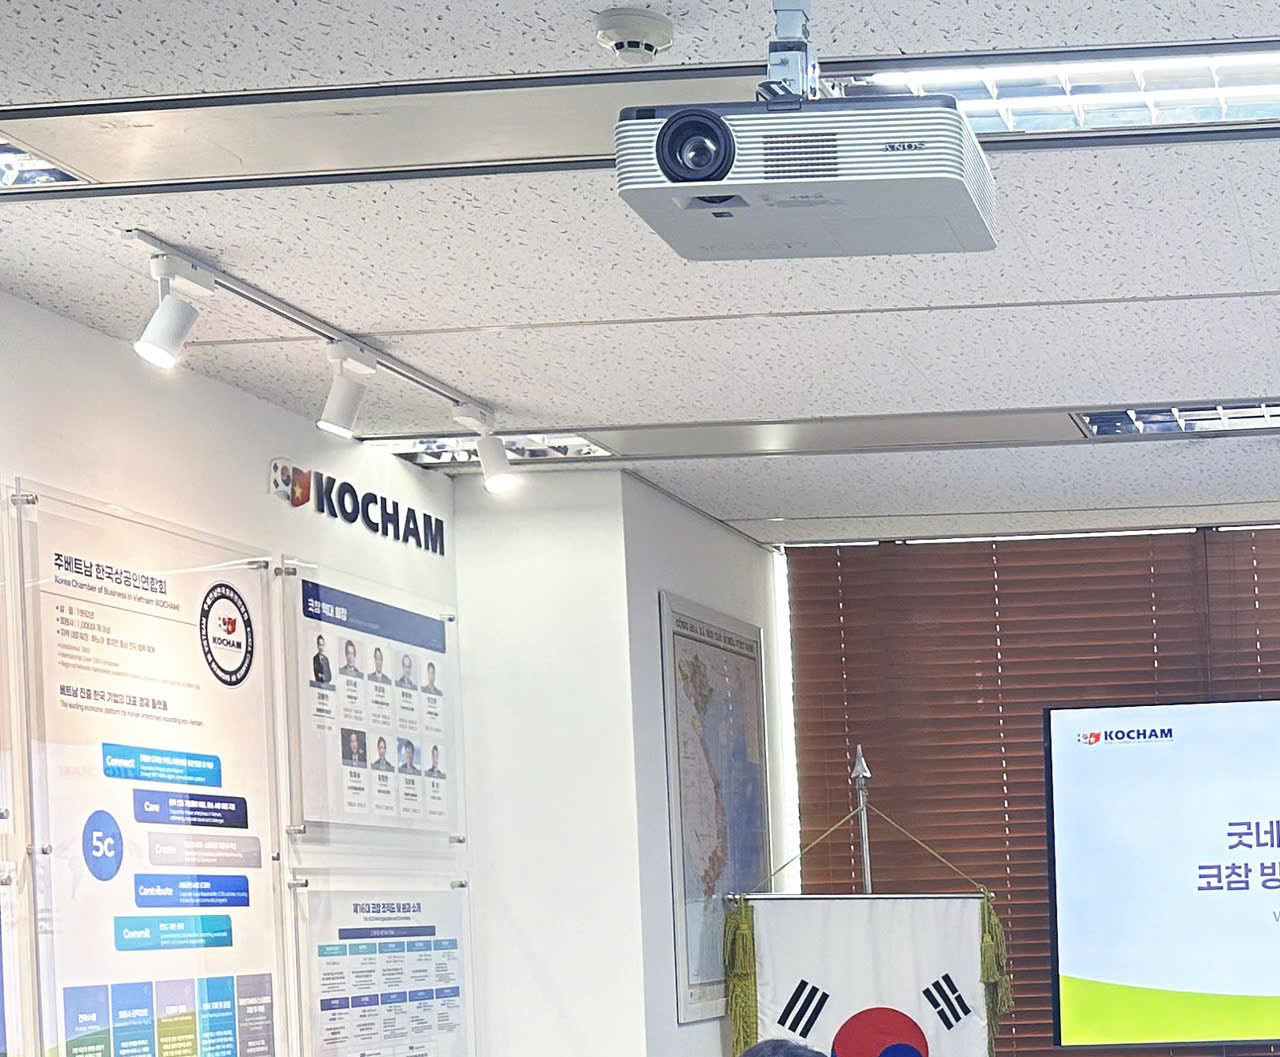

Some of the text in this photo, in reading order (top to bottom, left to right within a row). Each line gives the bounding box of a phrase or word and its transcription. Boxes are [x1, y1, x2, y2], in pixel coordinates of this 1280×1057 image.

[883, 142, 926, 152] SONY
[313, 471, 445, 556] KOCHAM
[54, 553, 167, 595] 주베트남 한국상공인연합회
[54, 575, 72, 587] Korea
[72, 579, 97, 593] Chamber
[308, 598, 320, 614] 코참
[212, 636, 242, 650] KOCHAM
[1104, 728, 1173, 741] KOCHAM
[1197, 862, 1252, 891] 코참
[139, 885, 173, 897] Contribute
